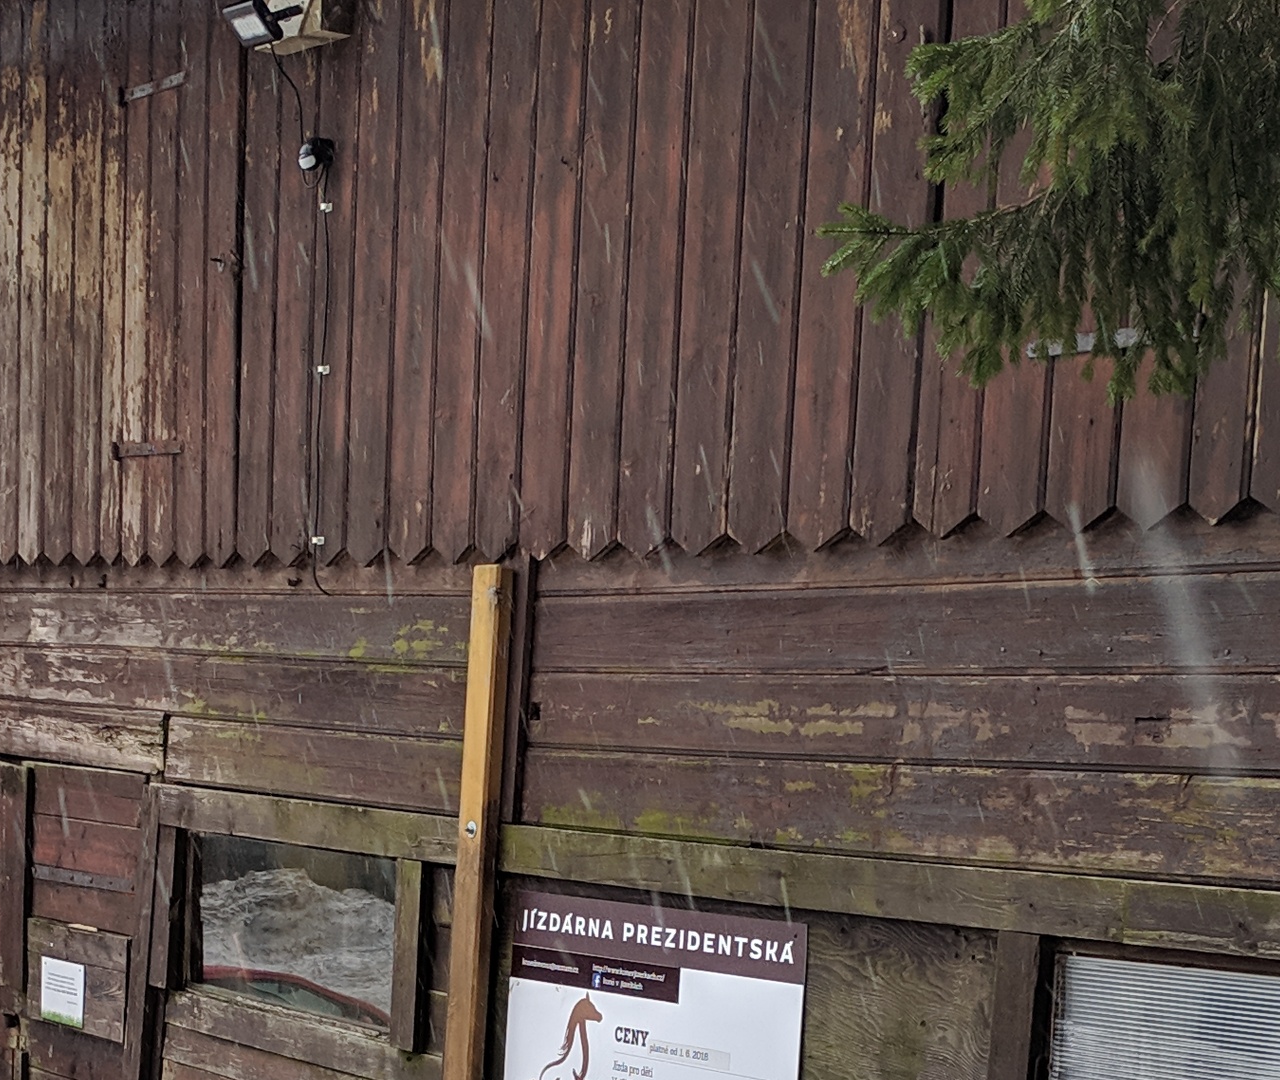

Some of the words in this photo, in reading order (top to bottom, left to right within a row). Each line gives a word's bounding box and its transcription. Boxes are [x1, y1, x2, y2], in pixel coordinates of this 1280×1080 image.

[521, 908, 614, 940] JÍZDÁRNA
[622, 922, 795, 965] PREZIDENTSKÁ
[615, 1026, 649, 1047] CENY
[670, 1047, 677, 1055] od
[692, 1051, 709, 1061] 2018
[629, 1067, 639, 1076] pro
